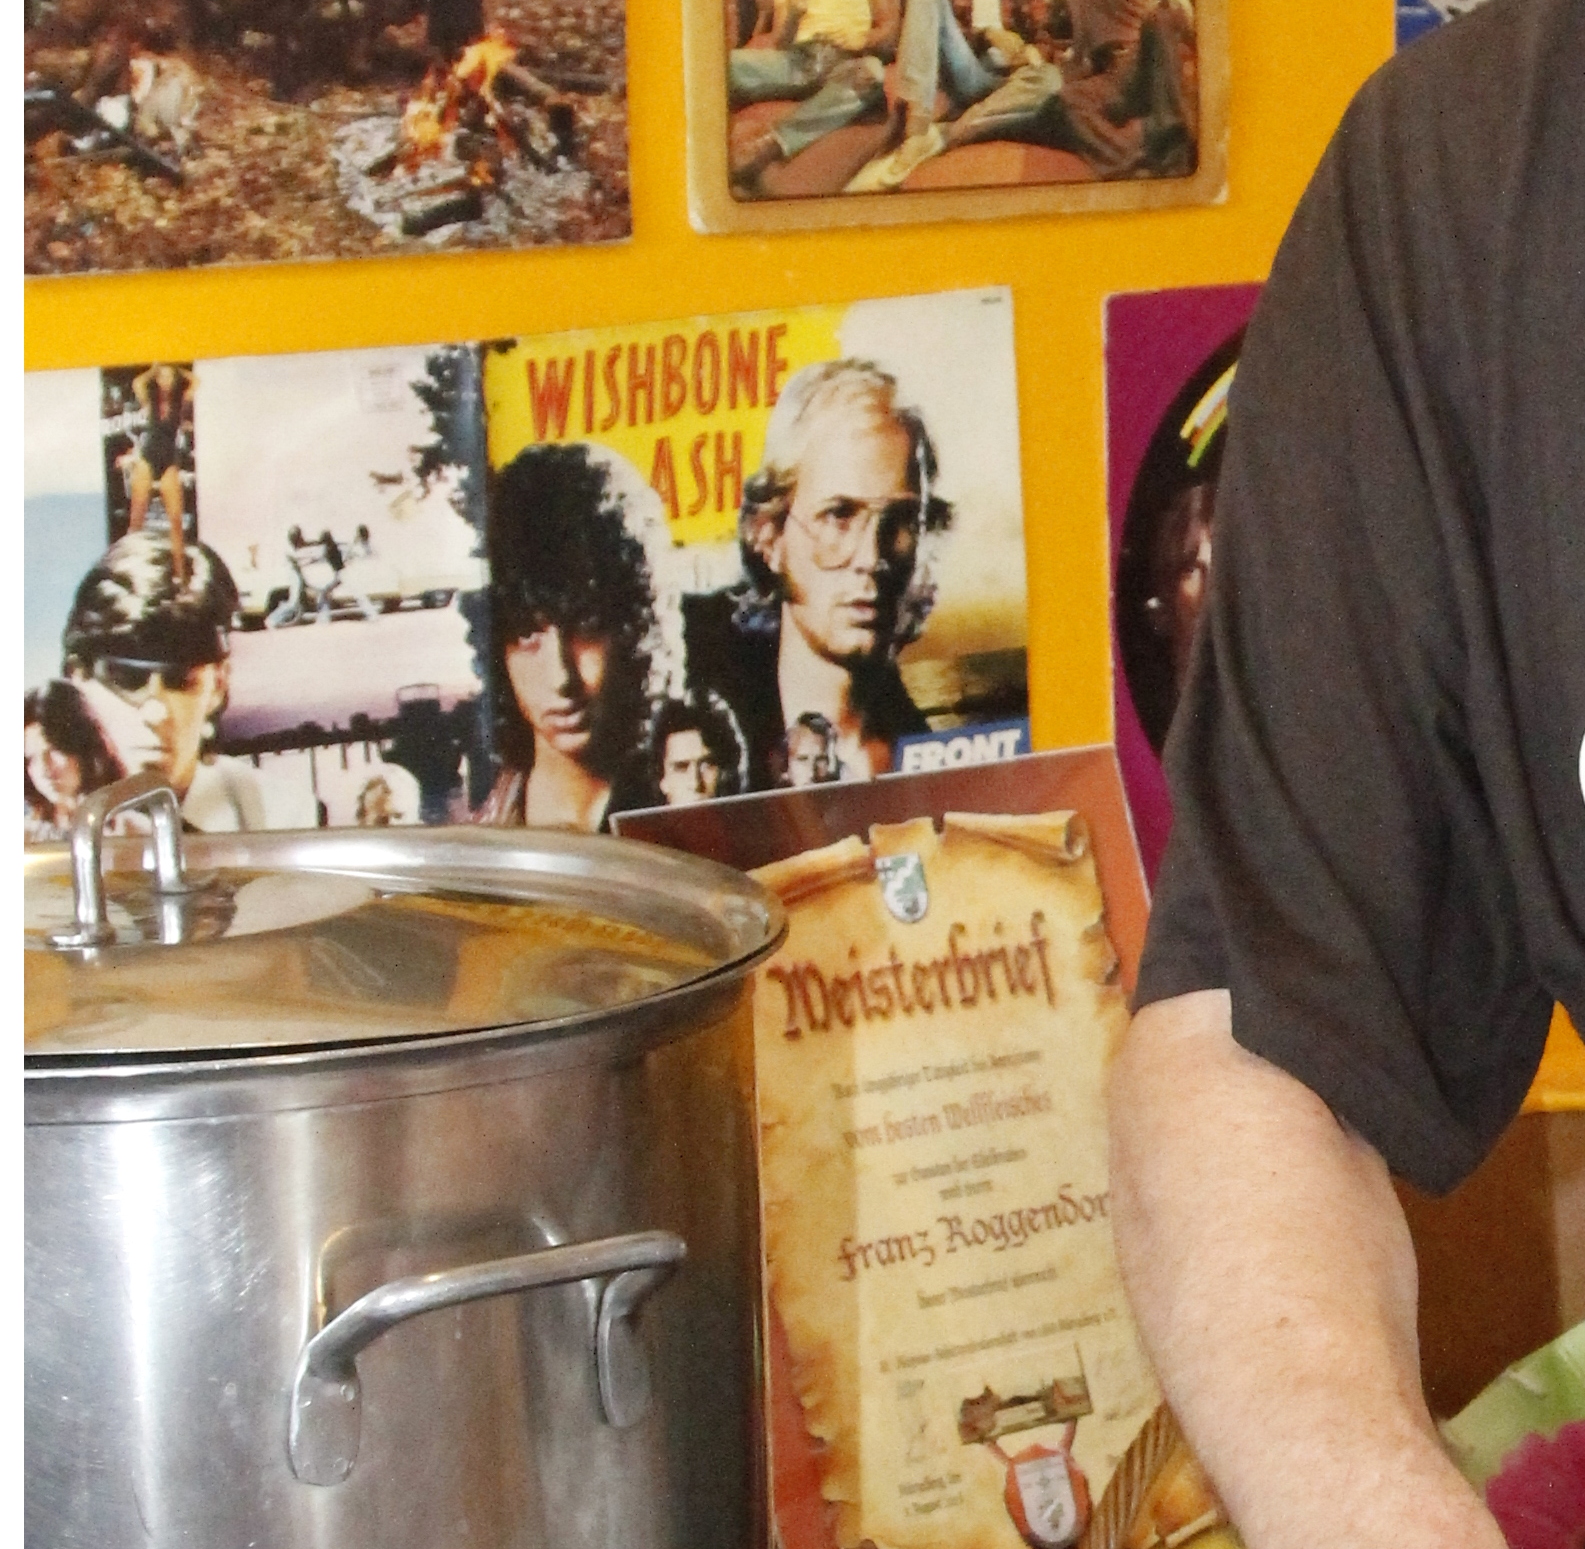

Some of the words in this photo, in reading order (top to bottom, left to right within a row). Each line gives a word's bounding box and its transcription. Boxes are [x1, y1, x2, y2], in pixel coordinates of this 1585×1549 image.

[526, 322, 789, 441] WISHBONE
[652, 429, 744, 520] ASH
[902, 728, 1022, 772] FRONT
[765, 909, 1056, 1042] Meisterbrief
[937, 1182, 1110, 1253] Roggendor
